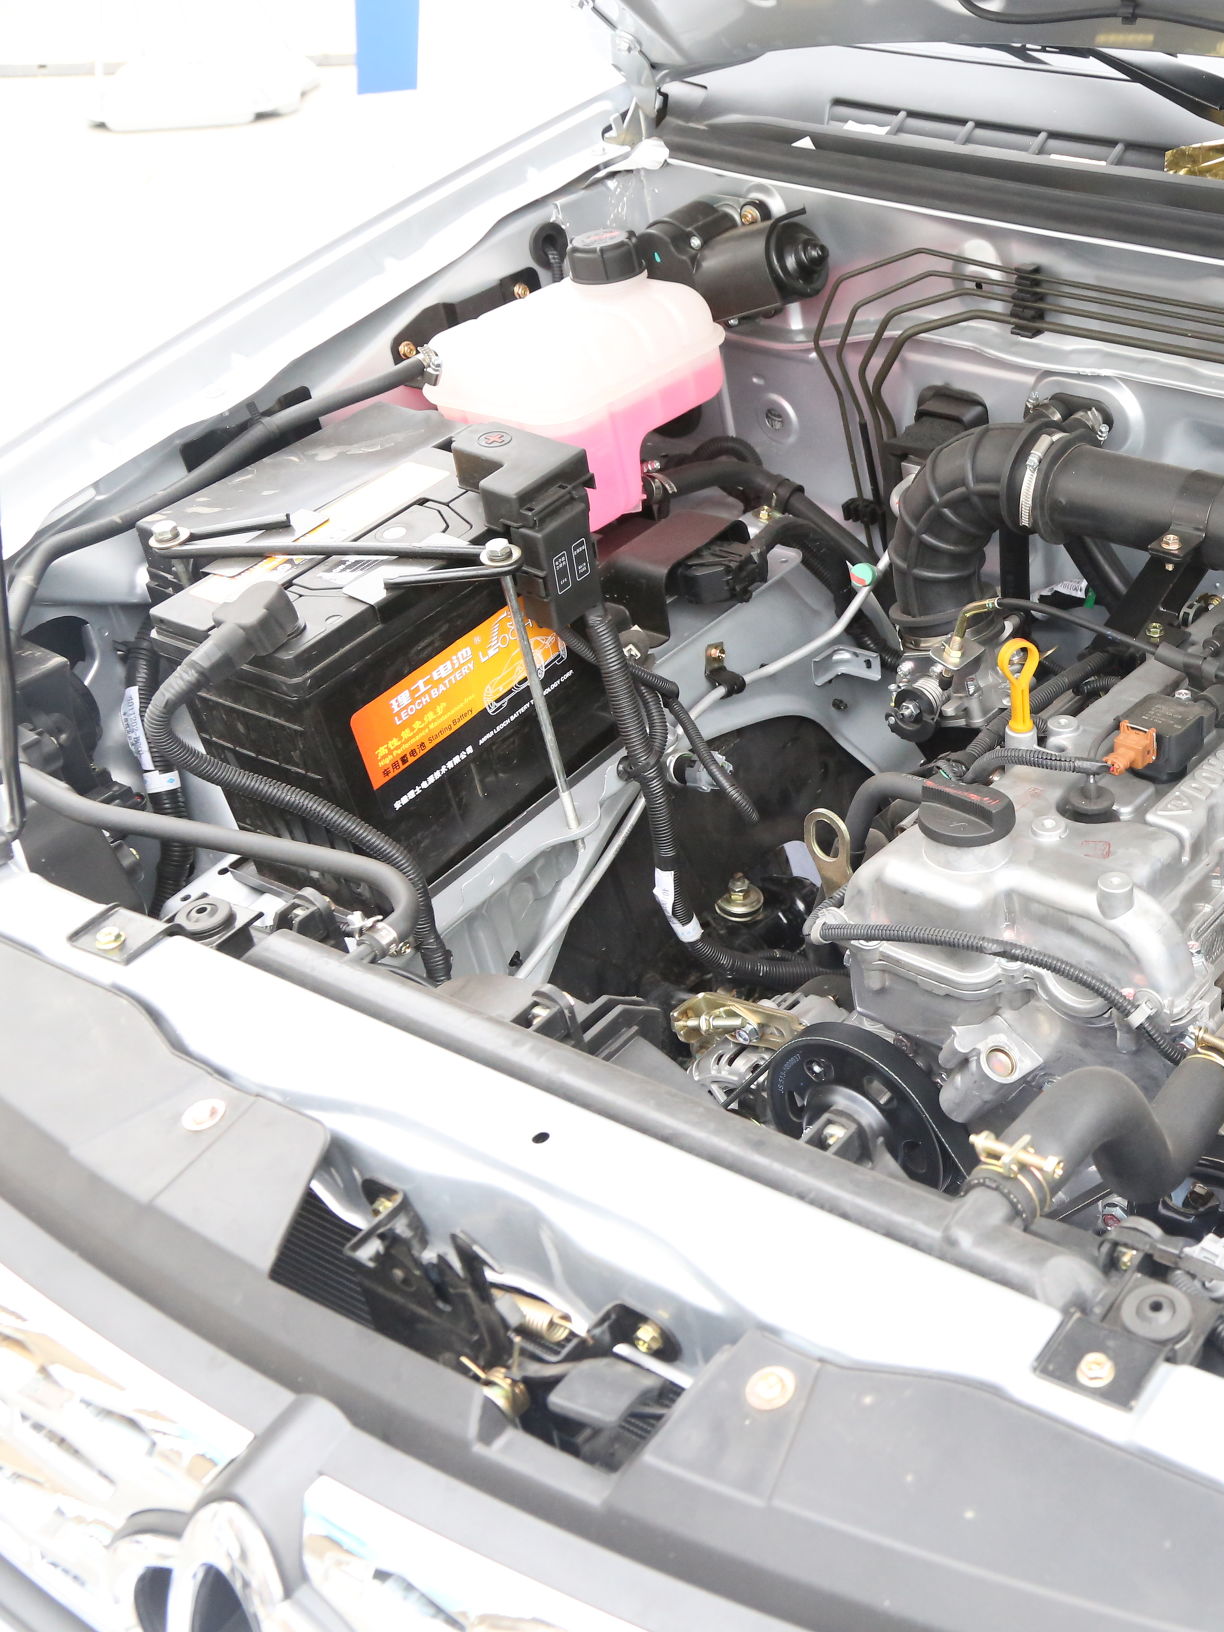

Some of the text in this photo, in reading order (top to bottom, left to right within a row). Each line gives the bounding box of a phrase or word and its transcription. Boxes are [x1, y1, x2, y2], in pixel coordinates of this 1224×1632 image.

[389, 646, 473, 713] 理士电池
[394, 660, 474, 725] LEOCH BATTERY
[375, 702, 447, 759] 高性能免维护
[427, 708, 474, 744] Starting Battery
[493, 718, 511, 734] LEOCH
[509, 701, 530, 722] BATTERY
[382, 741, 427, 778] 车用蓄电池
